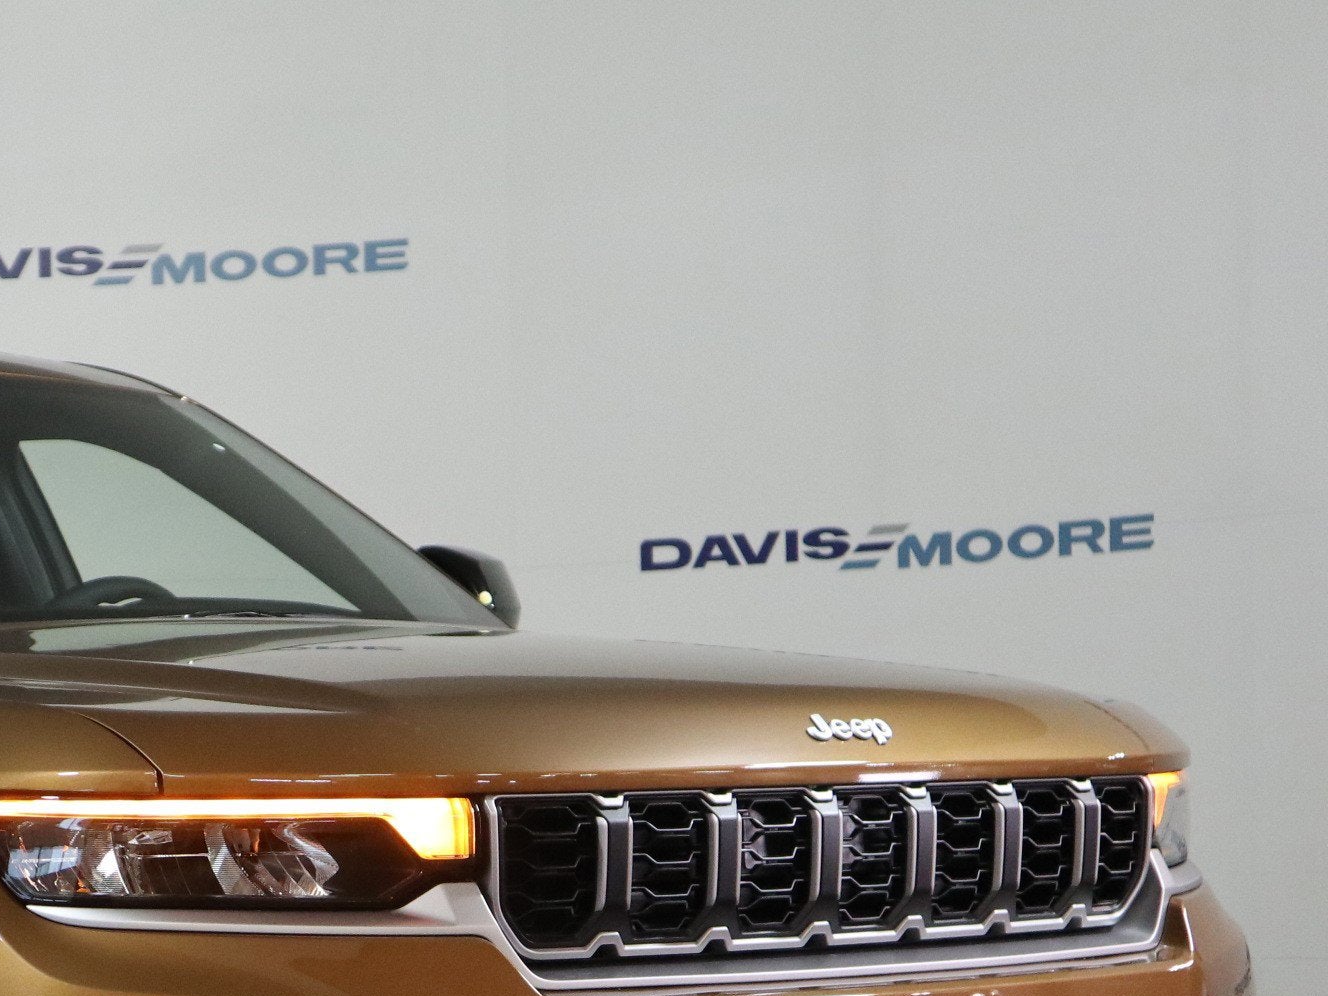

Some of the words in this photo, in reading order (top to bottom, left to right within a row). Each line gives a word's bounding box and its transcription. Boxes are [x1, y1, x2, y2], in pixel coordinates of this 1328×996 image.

[151, 238, 409, 286] MOORE
[639, 526, 851, 573] DAVIS
[896, 512, 1155, 571] MOORE
[806, 713, 893, 745] Jeep
